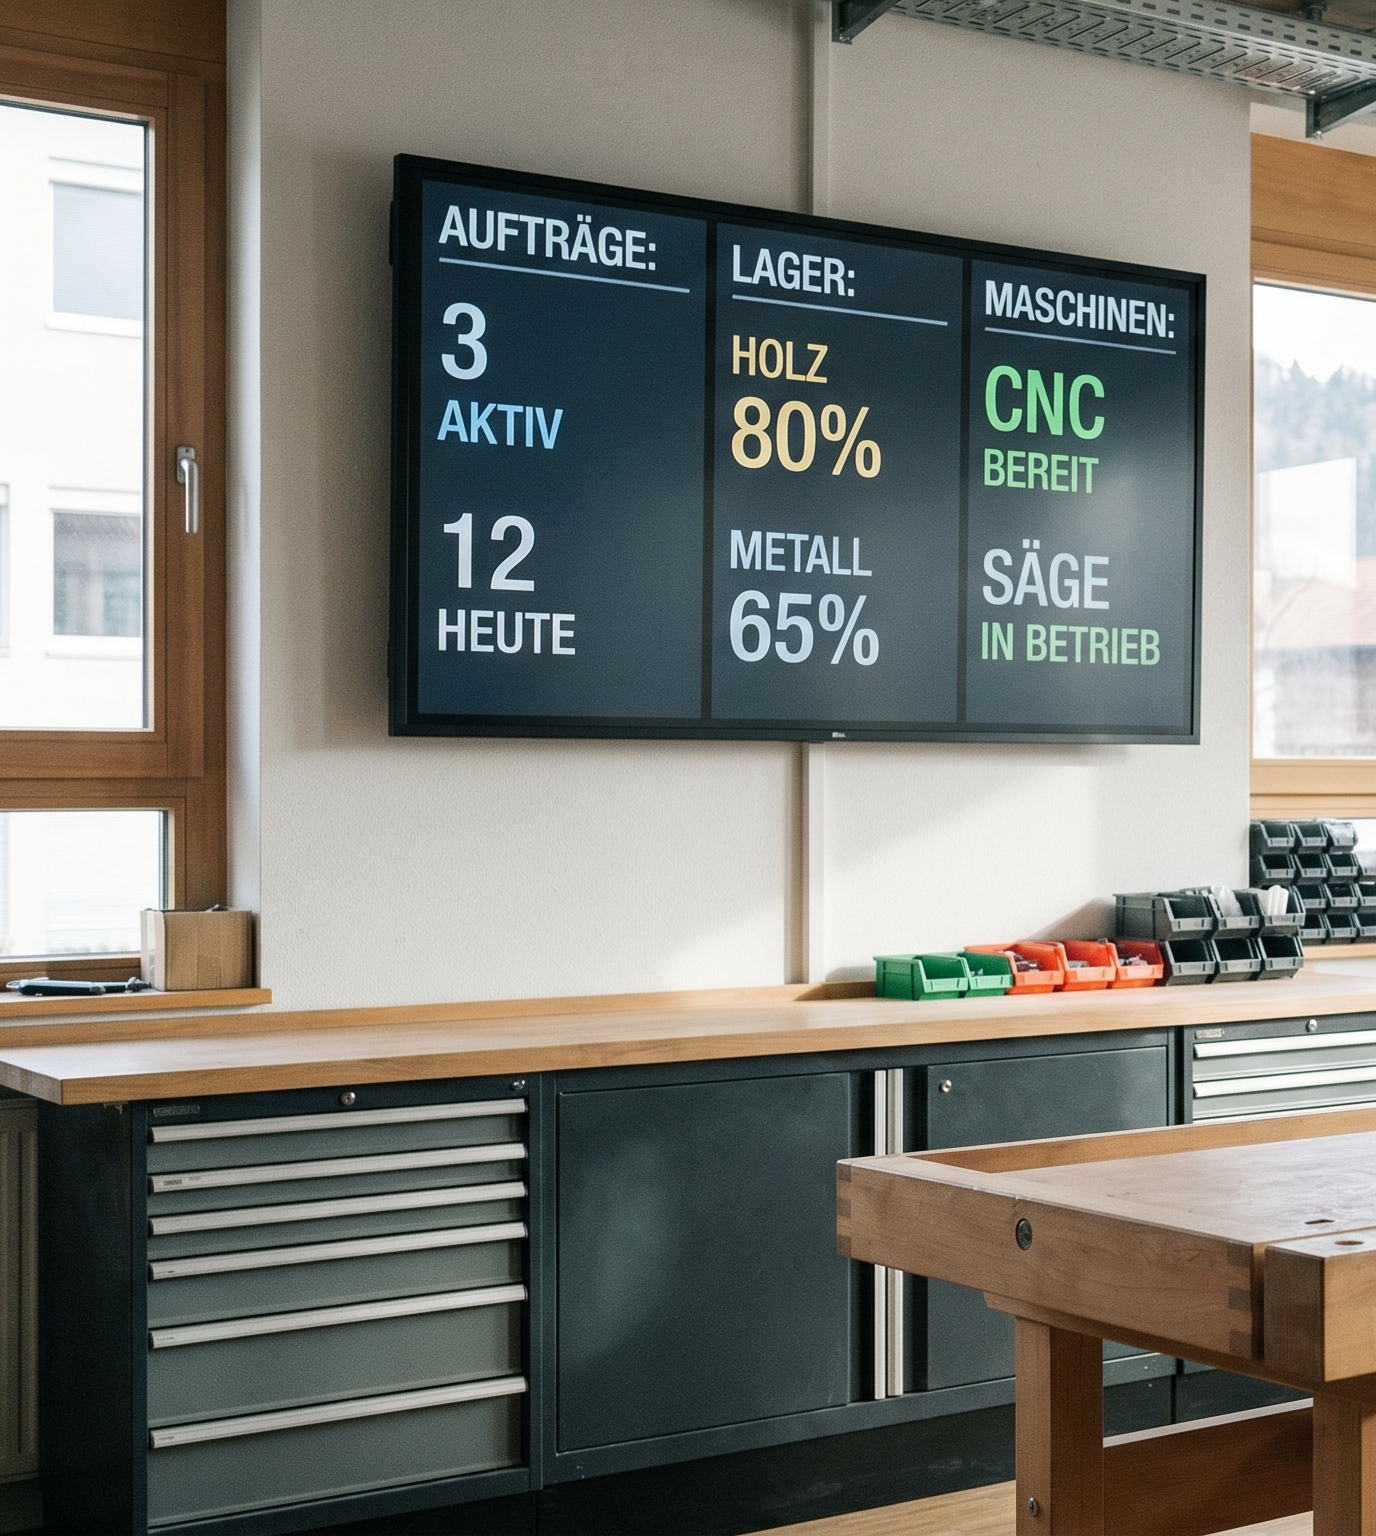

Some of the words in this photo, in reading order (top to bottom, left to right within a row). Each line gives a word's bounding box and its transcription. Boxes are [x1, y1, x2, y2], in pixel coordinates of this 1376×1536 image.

[438, 205, 656, 271] AUFTRÄGE:
[732, 244, 855, 297] LAGER:
[985, 279, 1175, 339] MASCHINEN:
[441, 302, 488, 380] 3
[732, 334, 828, 384] HOLZ
[437, 399, 563, 450] AKTIV
[985, 365, 1105, 440] CNC
[731, 396, 882, 478] 80%
[984, 448, 1099, 494] BEREIT
[443, 512, 535, 592] 12
[730, 529, 873, 577] METALL
[982, 538, 1110, 610] SÄGE
[438, 608, 576, 655] HEUTE
[729, 589, 880, 666] 65%
[981, 621, 1014, 661] IN
[1026, 623, 1160, 666] BETRIEB
